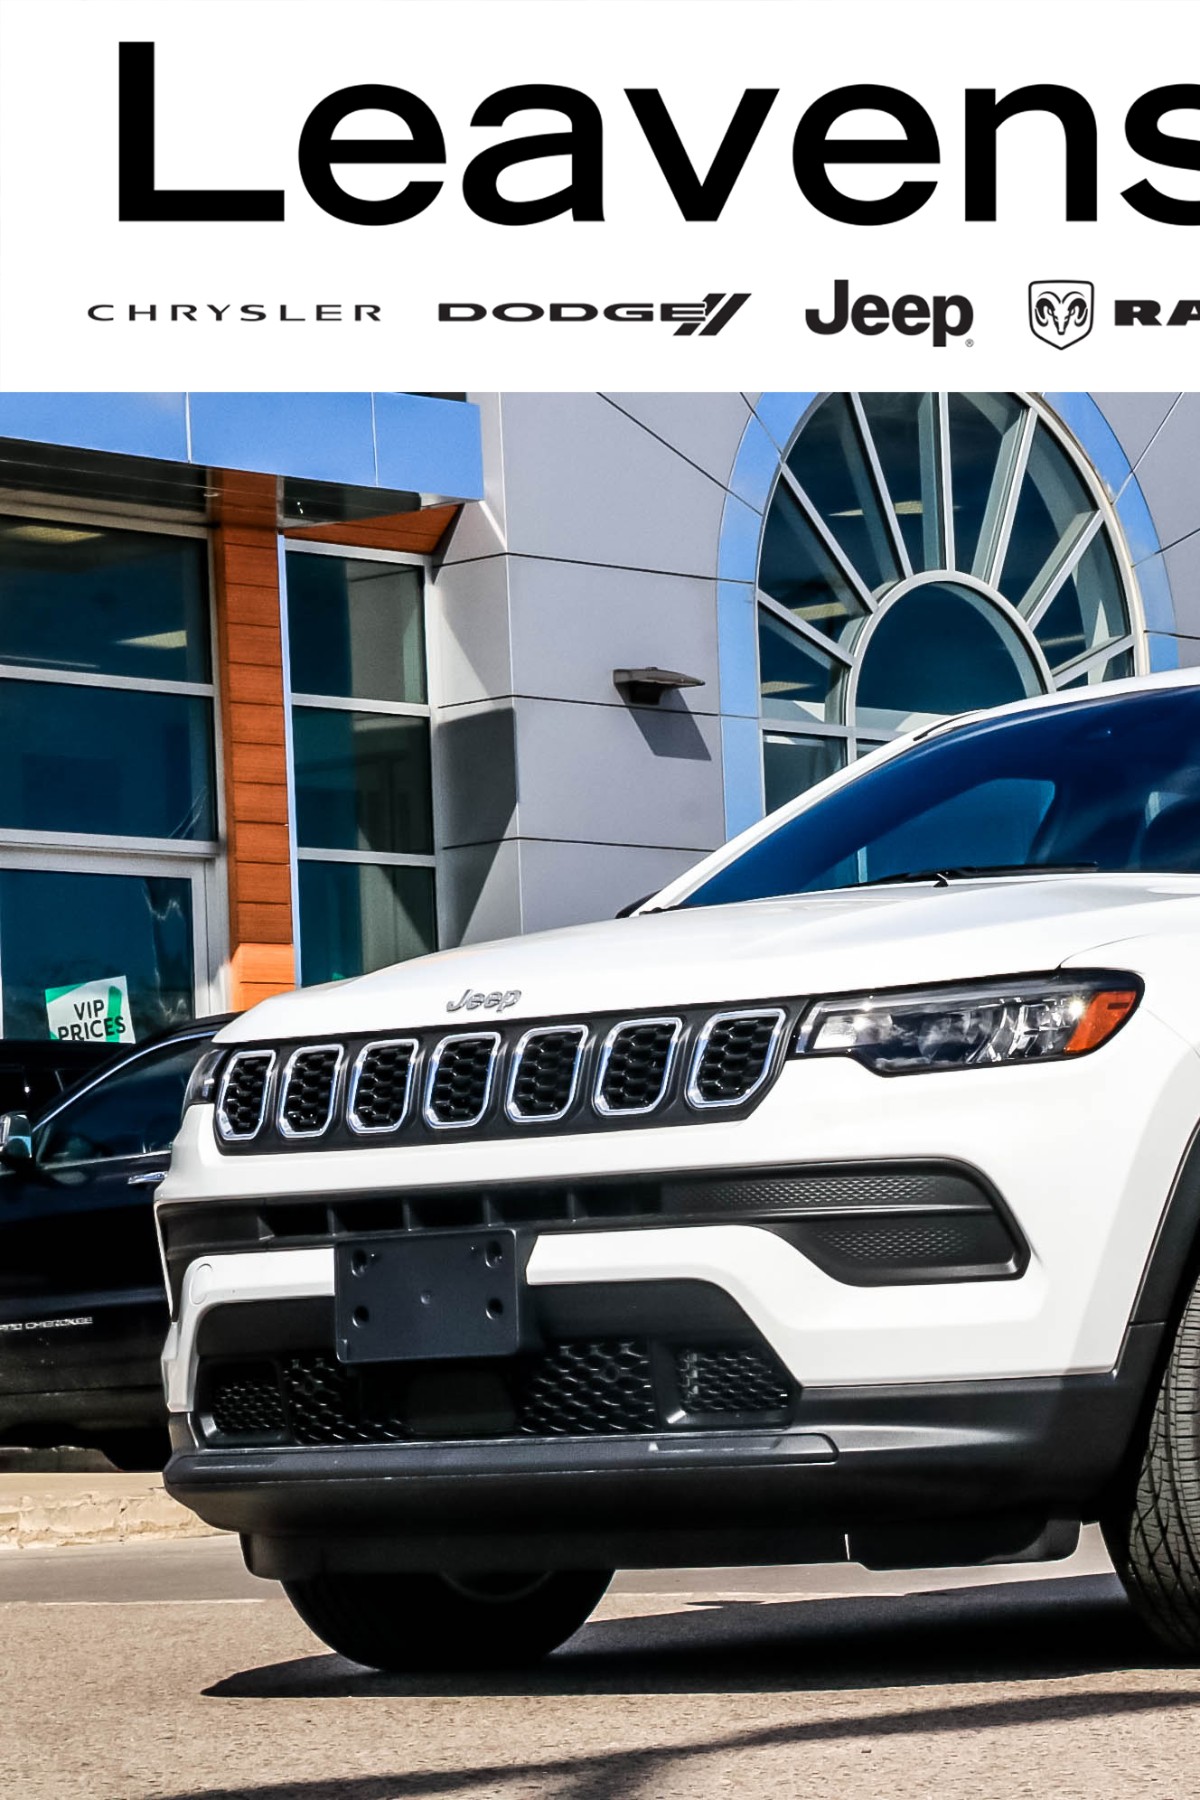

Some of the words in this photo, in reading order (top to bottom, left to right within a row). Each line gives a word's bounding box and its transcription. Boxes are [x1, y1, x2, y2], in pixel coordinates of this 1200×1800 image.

[73, 999, 105, 1021] VIP
[446, 988, 522, 1013] Jeep
[57, 1015, 127, 1041] PRICES
